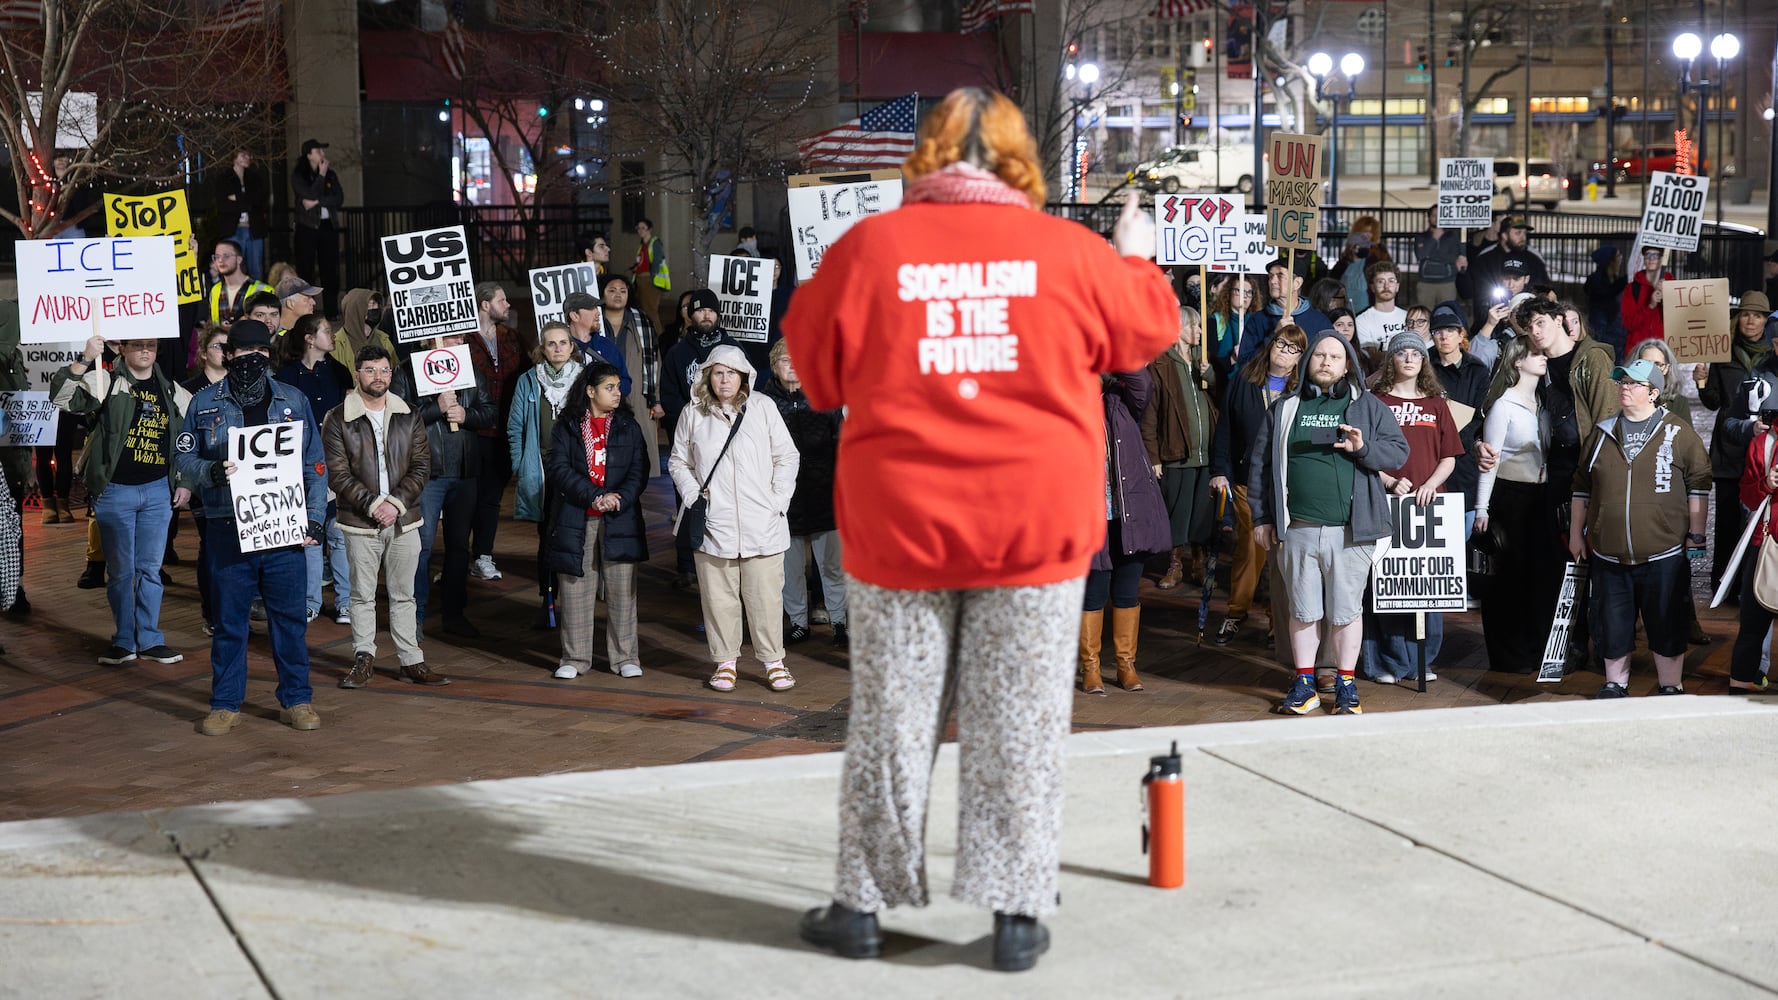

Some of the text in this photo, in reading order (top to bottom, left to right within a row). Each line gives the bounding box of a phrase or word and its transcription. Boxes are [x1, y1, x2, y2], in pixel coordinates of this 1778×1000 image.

[1274, 140, 1316, 179] UN
[1446, 164, 1486, 178] DAYTON
[1268, 180, 1318, 208] MASK
[1440, 180, 1491, 191] MINNEAPOLIS
[1664, 175, 1697, 188] NO
[820, 184, 880, 220] ICE
[1163, 195, 1234, 225] STOP
[1440, 195, 1491, 204] STOP
[1440, 205, 1490, 218] ICE TERROR
[1651, 185, 1703, 212] BLOOD
[112, 196, 176, 230] STOP
[1271, 208, 1314, 244] ICE
[1645, 210, 1697, 237] FOR OIL
[798, 226, 818, 245] IS
[1245, 222, 1267, 235] UMA
[45, 240, 134, 272] ICE
[384, 231, 464, 264] US
[1163, 226, 1239, 262] ICE
[390, 258, 466, 285] OUT
[721, 258, 761, 296] ICE
[898, 260, 1037, 302] SOCIALISM
[394, 281, 472, 308] OF THE
[533, 266, 594, 306] STOP
[1674, 284, 1715, 308] ICE
[32, 292, 165, 324] MURDERERS
[396, 298, 476, 328] CARIBBEAN
[720, 300, 762, 316] UT OF OUR
[926, 297, 1010, 337] IS THE
[720, 315, 767, 331] MMUNITIES
[918, 334, 1019, 375] FUTURE
[1667, 334, 1730, 358] GESTAPO
[427, 358, 457, 376] ICE
[8, 411, 52, 421] SISTING
[1403, 401, 1423, 414] Dr
[137, 438, 159, 451] Mess
[238, 426, 294, 460] ICE
[235, 483, 304, 524] GESTAPO
[240, 515, 297, 540] ENOUGH IS
[1390, 496, 1446, 549] ICE
[253, 526, 308, 550] ENOUGH
[1382, 557, 1454, 576] OUT OF OUR
[1376, 577, 1464, 596] COMMUNITIES
